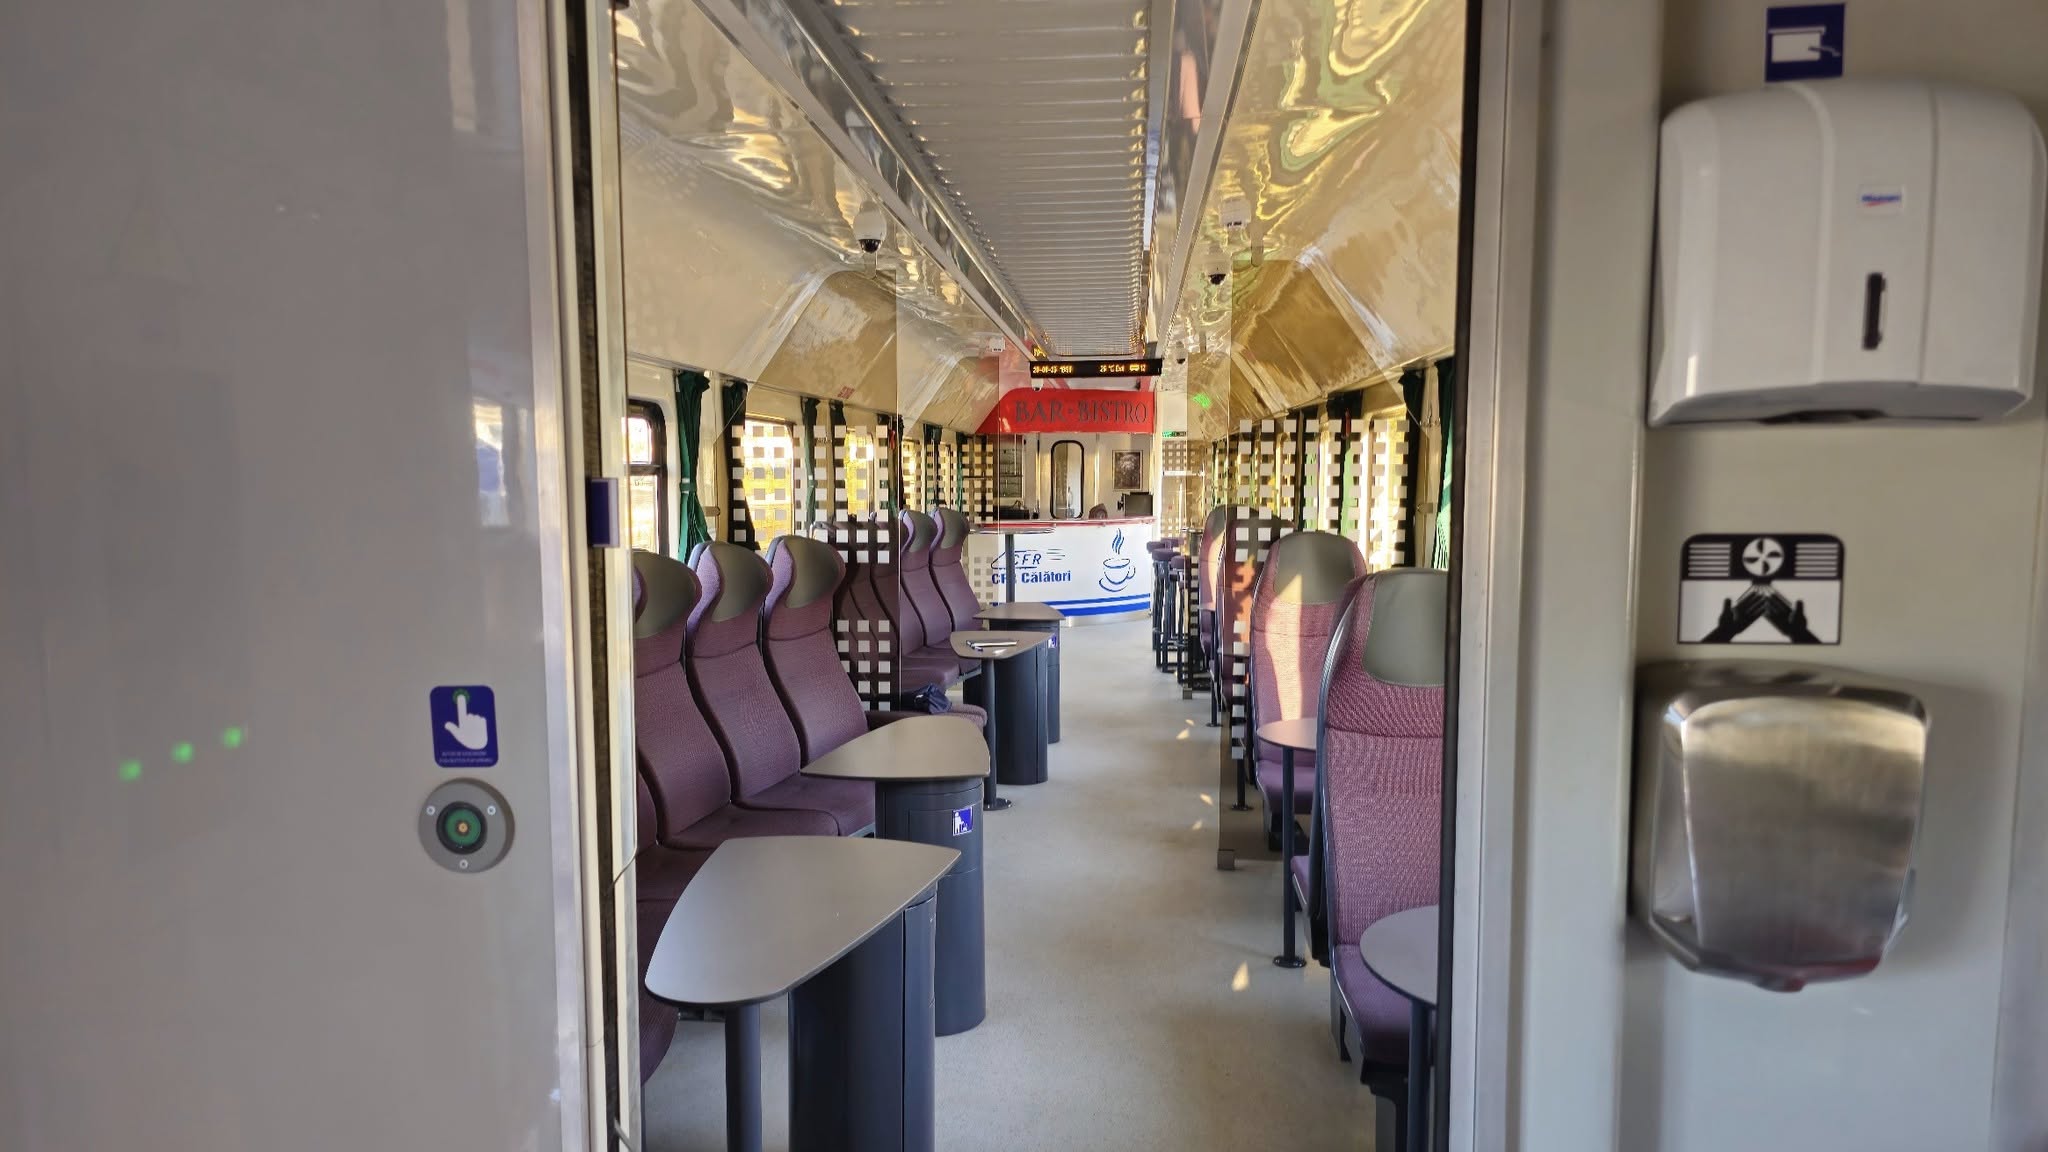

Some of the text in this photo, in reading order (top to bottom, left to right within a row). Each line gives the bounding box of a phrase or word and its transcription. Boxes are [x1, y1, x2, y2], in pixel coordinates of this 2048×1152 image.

[1015, 400, 1148, 424] BAR BISTRO
[1021, 570, 1071, 584] Călători
